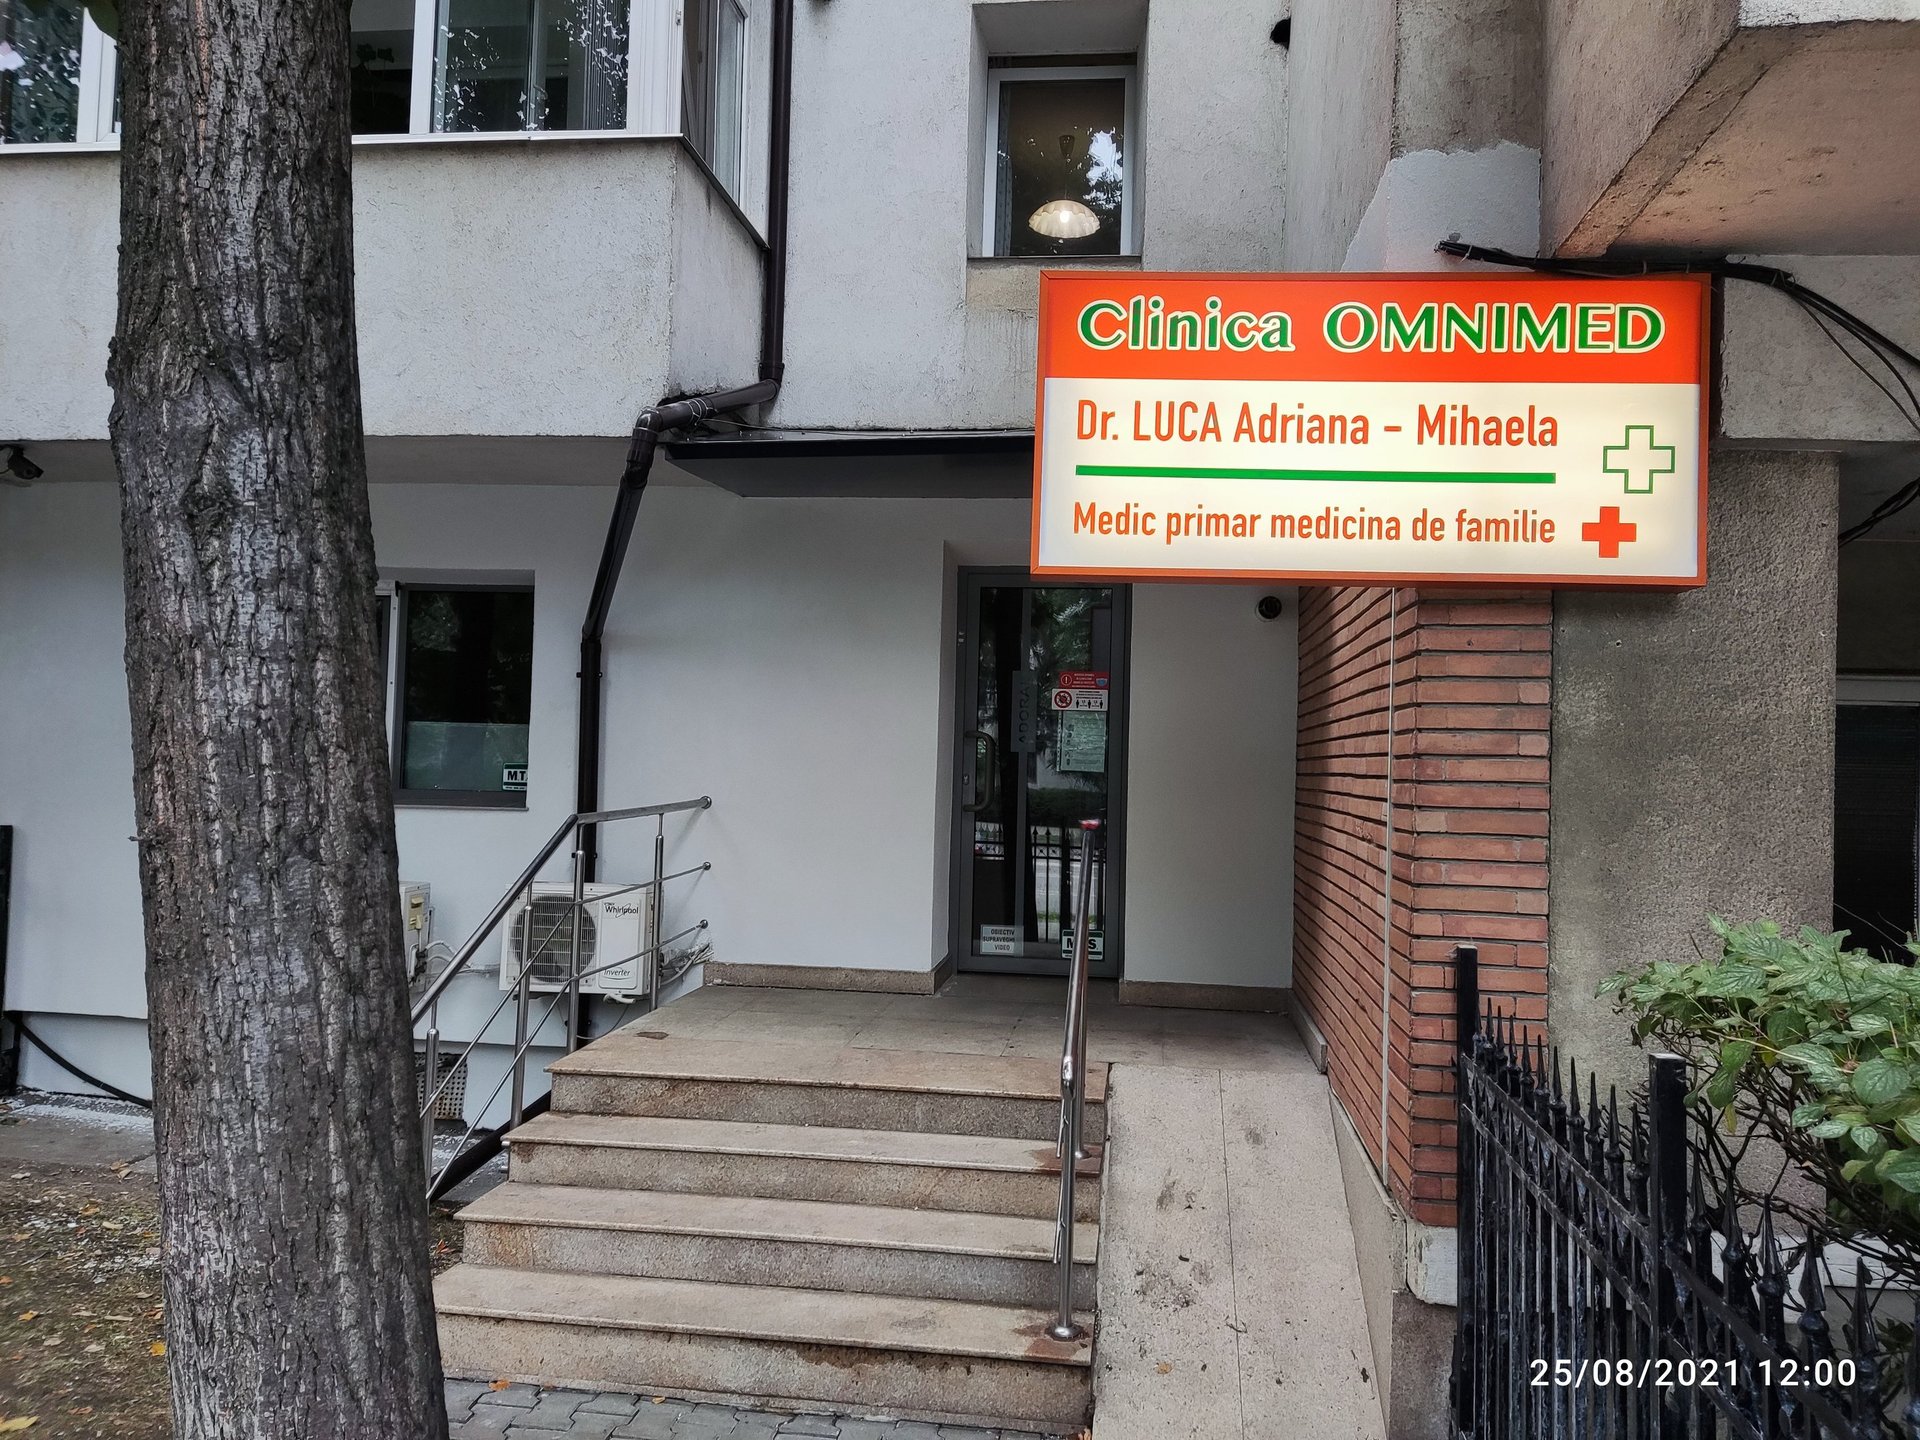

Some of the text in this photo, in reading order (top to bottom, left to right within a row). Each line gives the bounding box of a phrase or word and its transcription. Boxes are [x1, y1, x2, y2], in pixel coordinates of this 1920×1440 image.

[1078, 295, 1666, 355] Clinica OMNIMED
[1076, 399, 1119, 441] Dr.
[1133, 401, 1222, 443] LUCA
[1233, 402, 1370, 445] Adriana
[1416, 404, 1558, 447] Mihaela
[1073, 501, 1556, 545] Medic primar medicina de familie
[604, 904, 639, 916] Whirlpool
